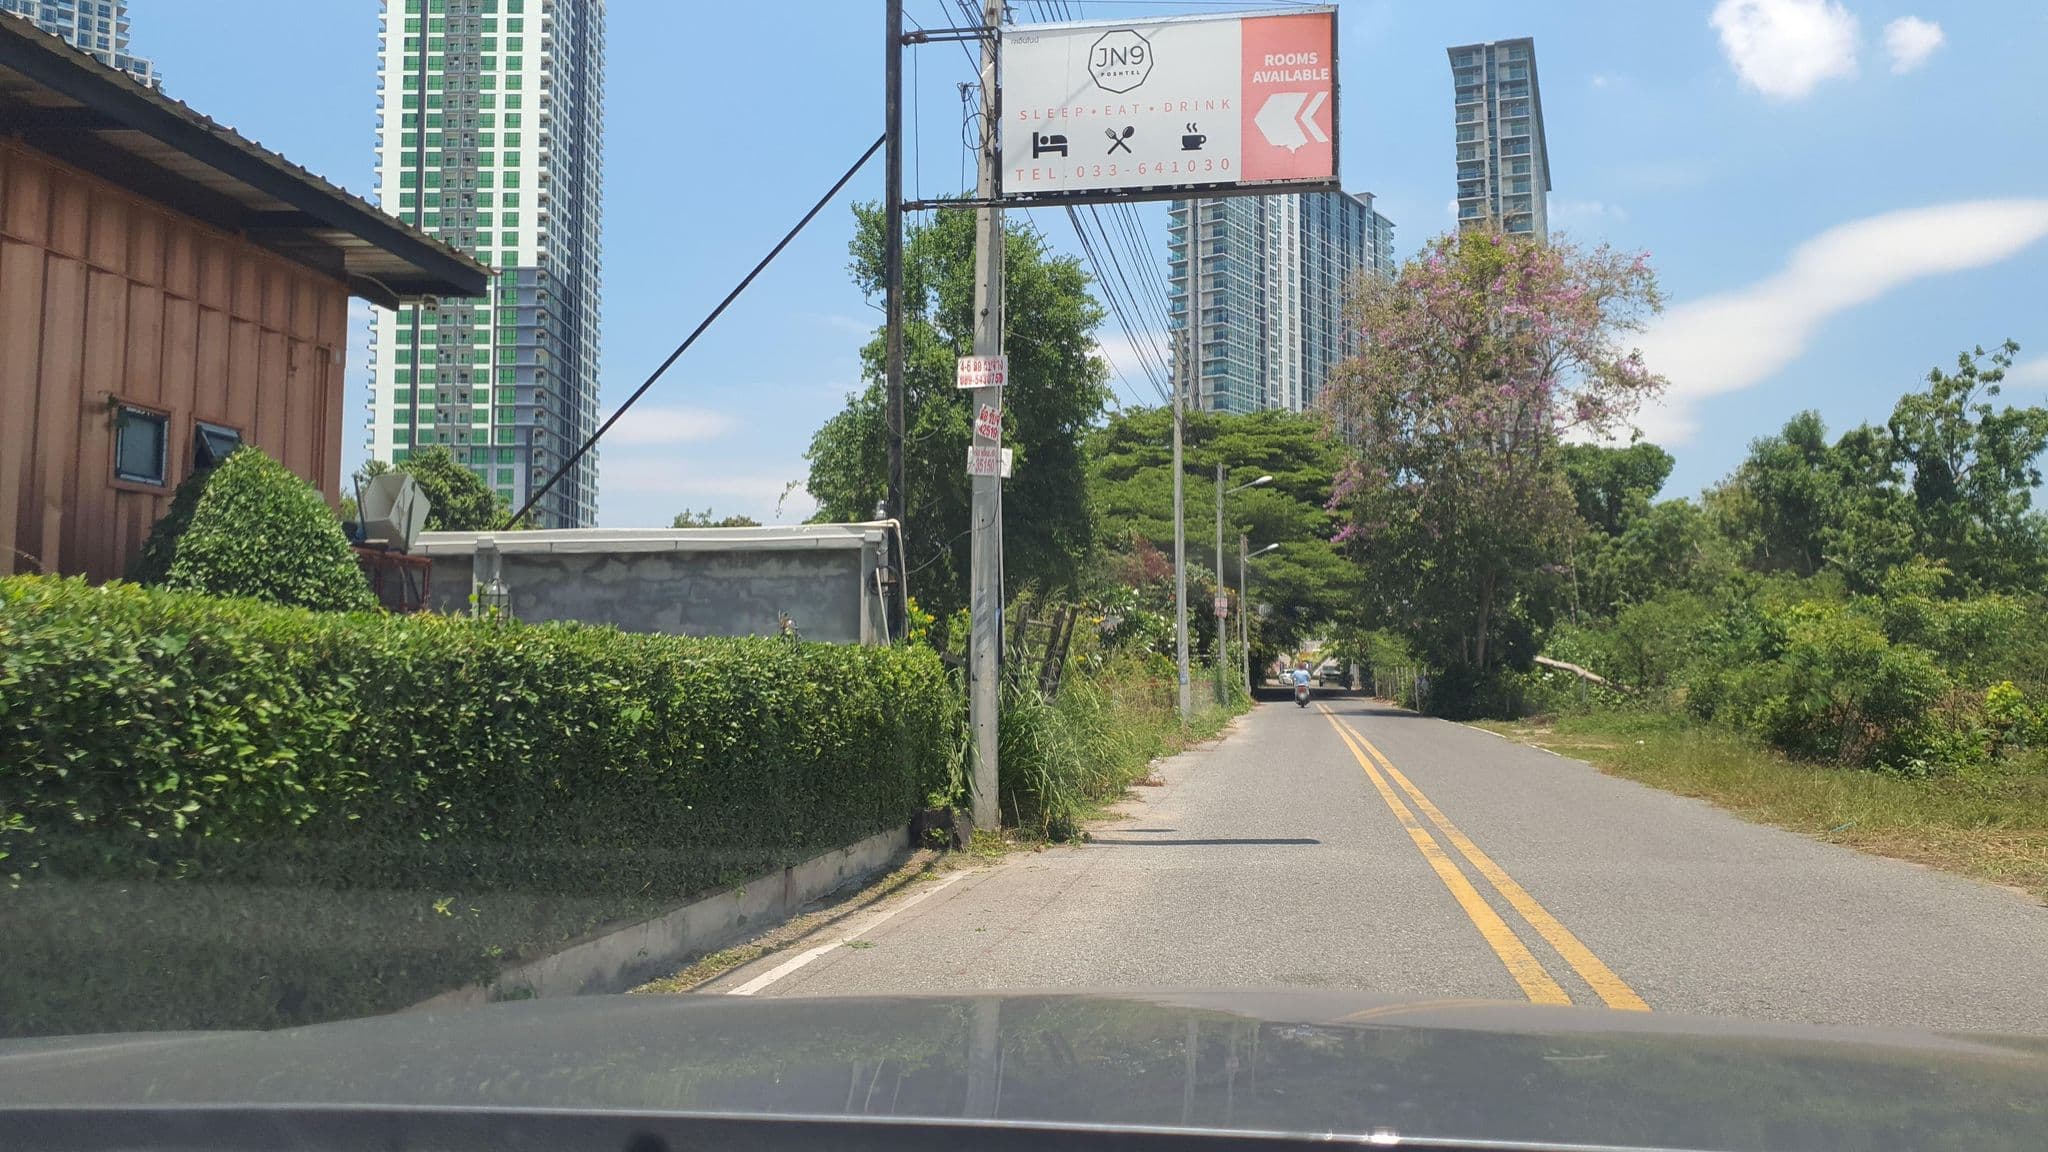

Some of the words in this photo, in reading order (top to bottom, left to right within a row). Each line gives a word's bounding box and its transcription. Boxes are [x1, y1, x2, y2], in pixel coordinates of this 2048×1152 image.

[1096, 45, 1144, 68] JN9
[1264, 52, 1318, 66] ROOMS
[1253, 67, 1329, 83] AVAILABLE
